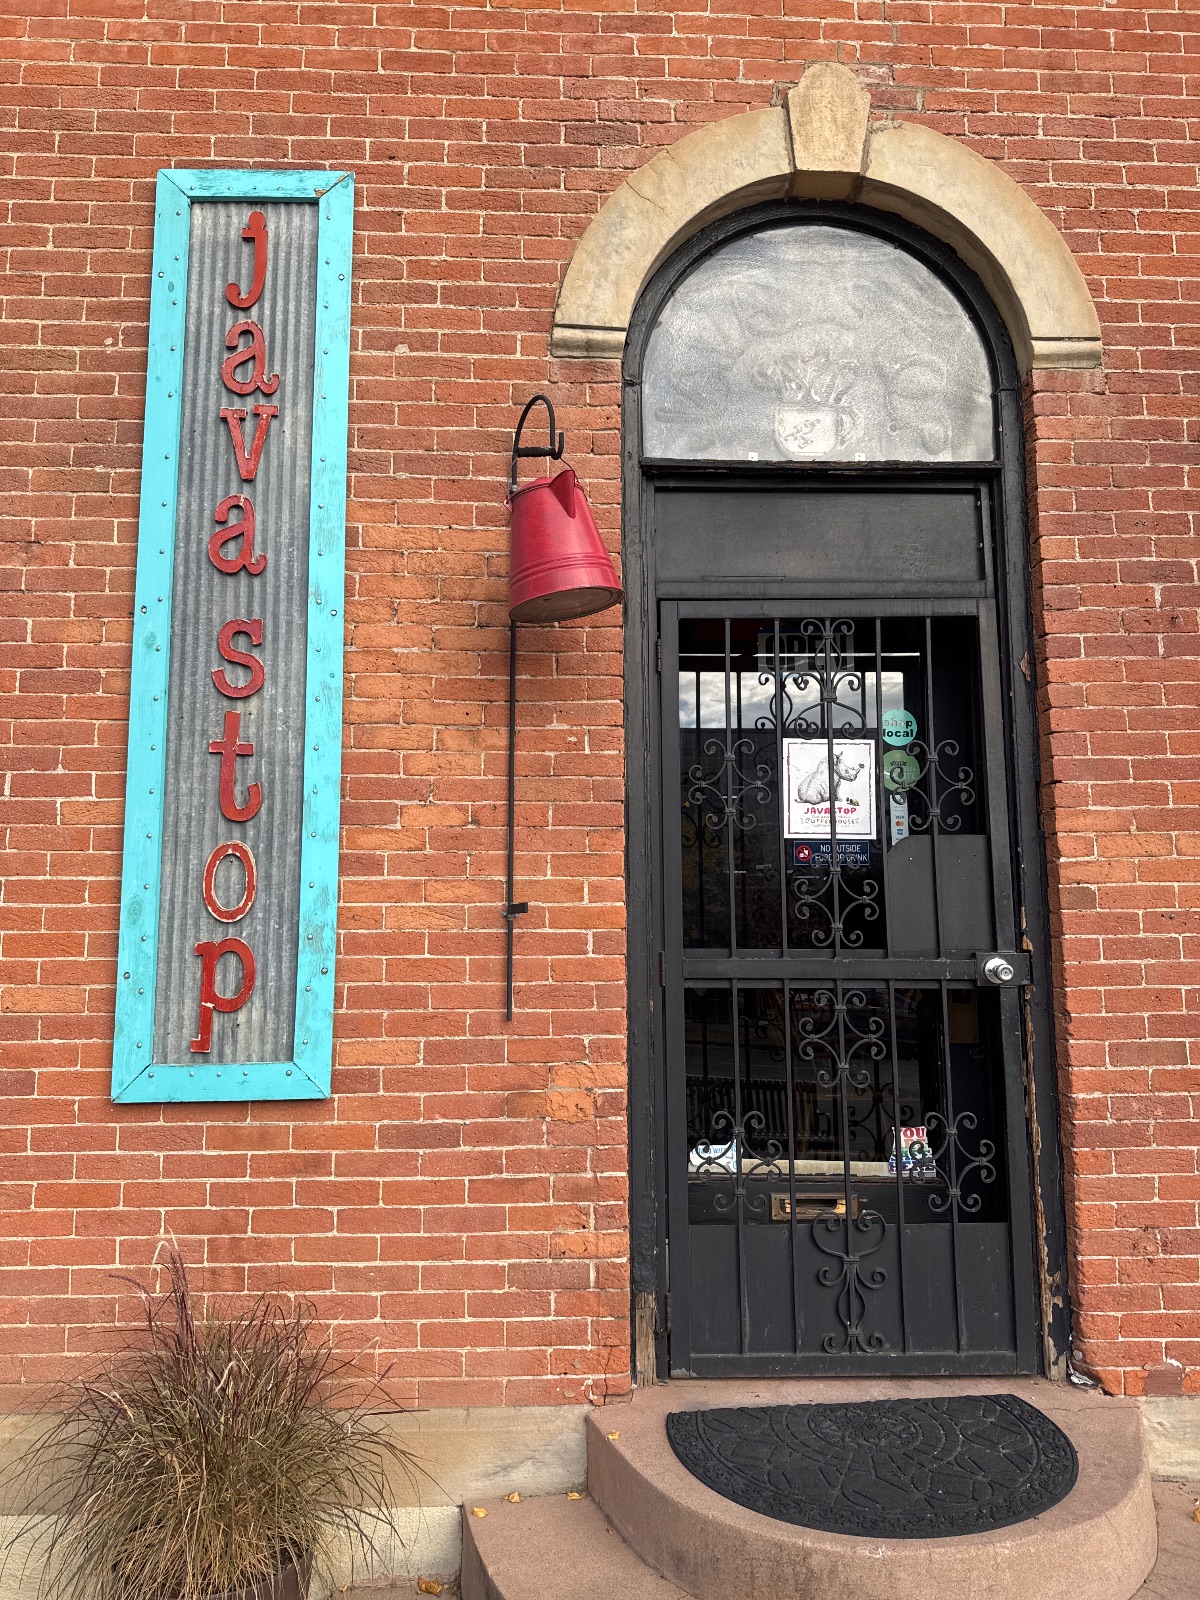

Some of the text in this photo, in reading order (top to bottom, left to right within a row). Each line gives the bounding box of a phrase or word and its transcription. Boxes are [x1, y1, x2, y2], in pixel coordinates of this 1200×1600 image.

[190, 211, 280, 1053] java stop
[765, 634, 848, 671] OPEN
[883, 718, 913, 729] shop
[882, 728, 914, 738] local
[803, 806, 857, 815] JAVATOP
[820, 844, 862, 853] NO UTSIDE
